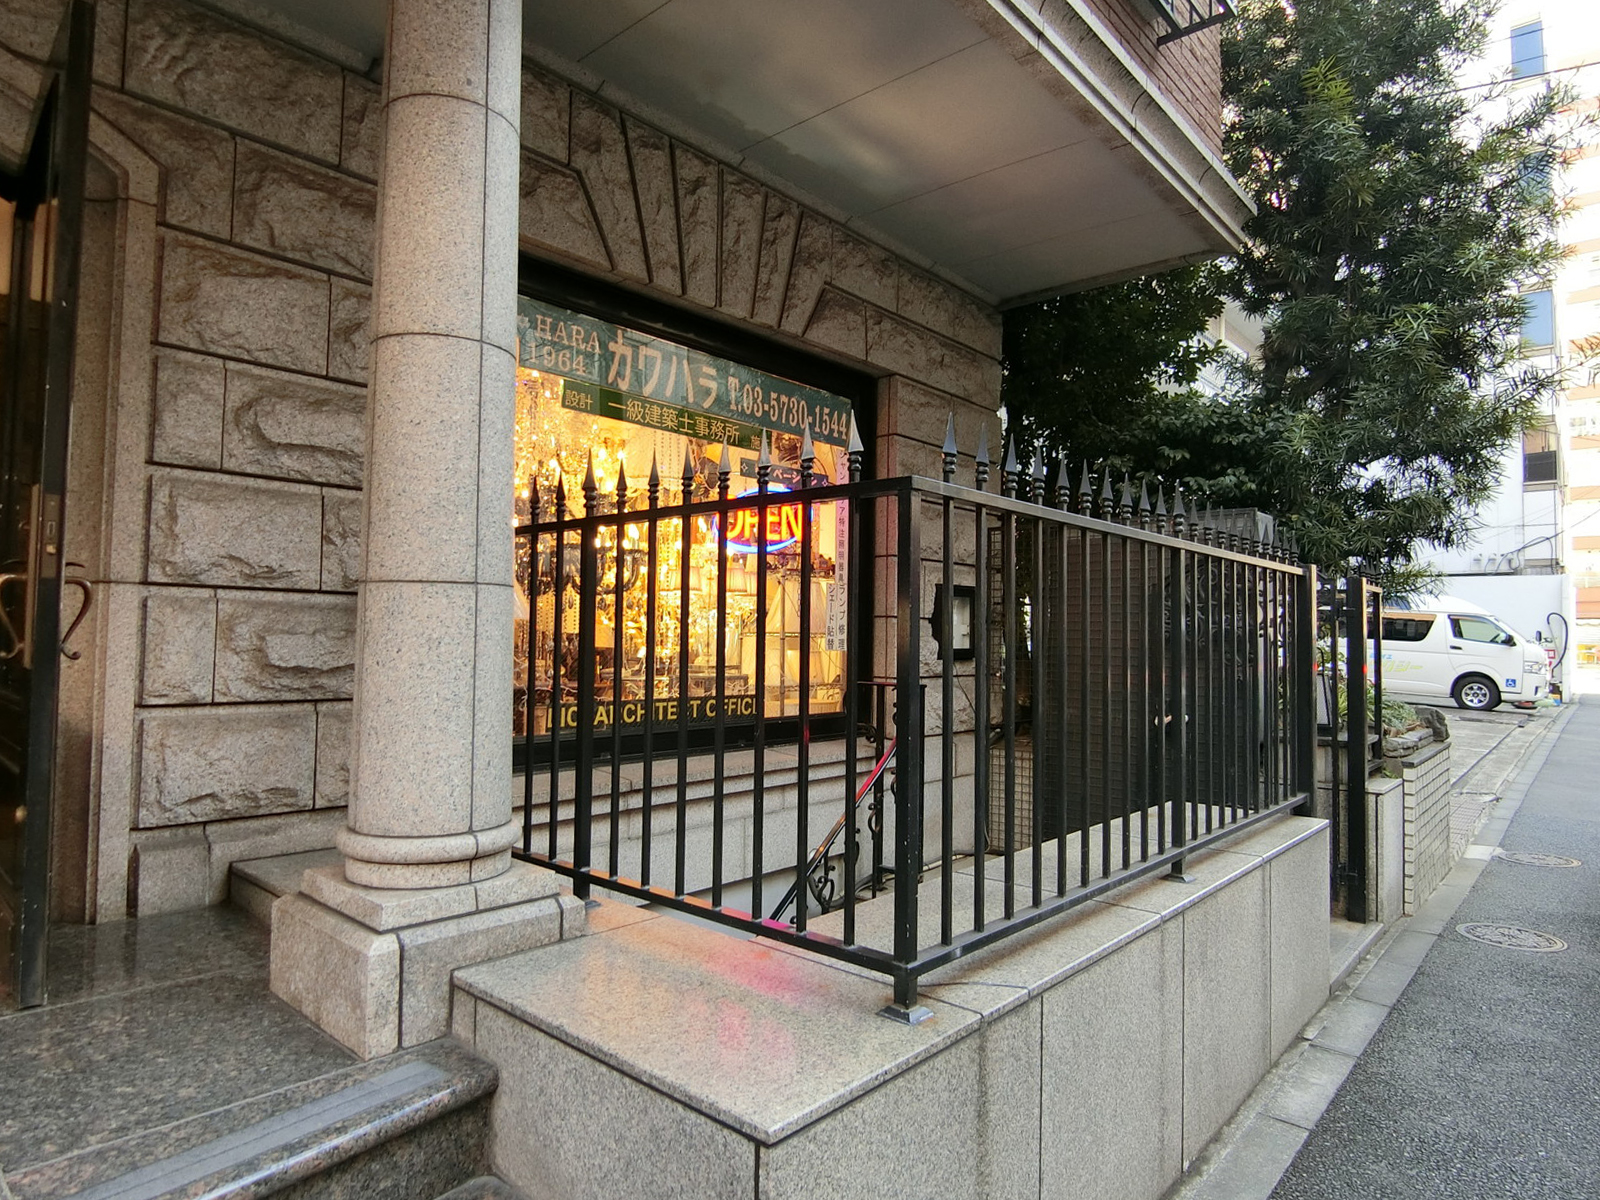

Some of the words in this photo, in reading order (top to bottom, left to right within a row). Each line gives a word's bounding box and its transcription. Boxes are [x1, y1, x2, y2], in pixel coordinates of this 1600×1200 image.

[535, 314, 601, 354] HARA
[528, 341, 586, 376] 1964
[607, 329, 718, 409] カワハラ
[565, 389, 594, 411] 設計
[608, 398, 740, 446] 一級建築士事務所
[705, 698, 758, 717] OFIC
